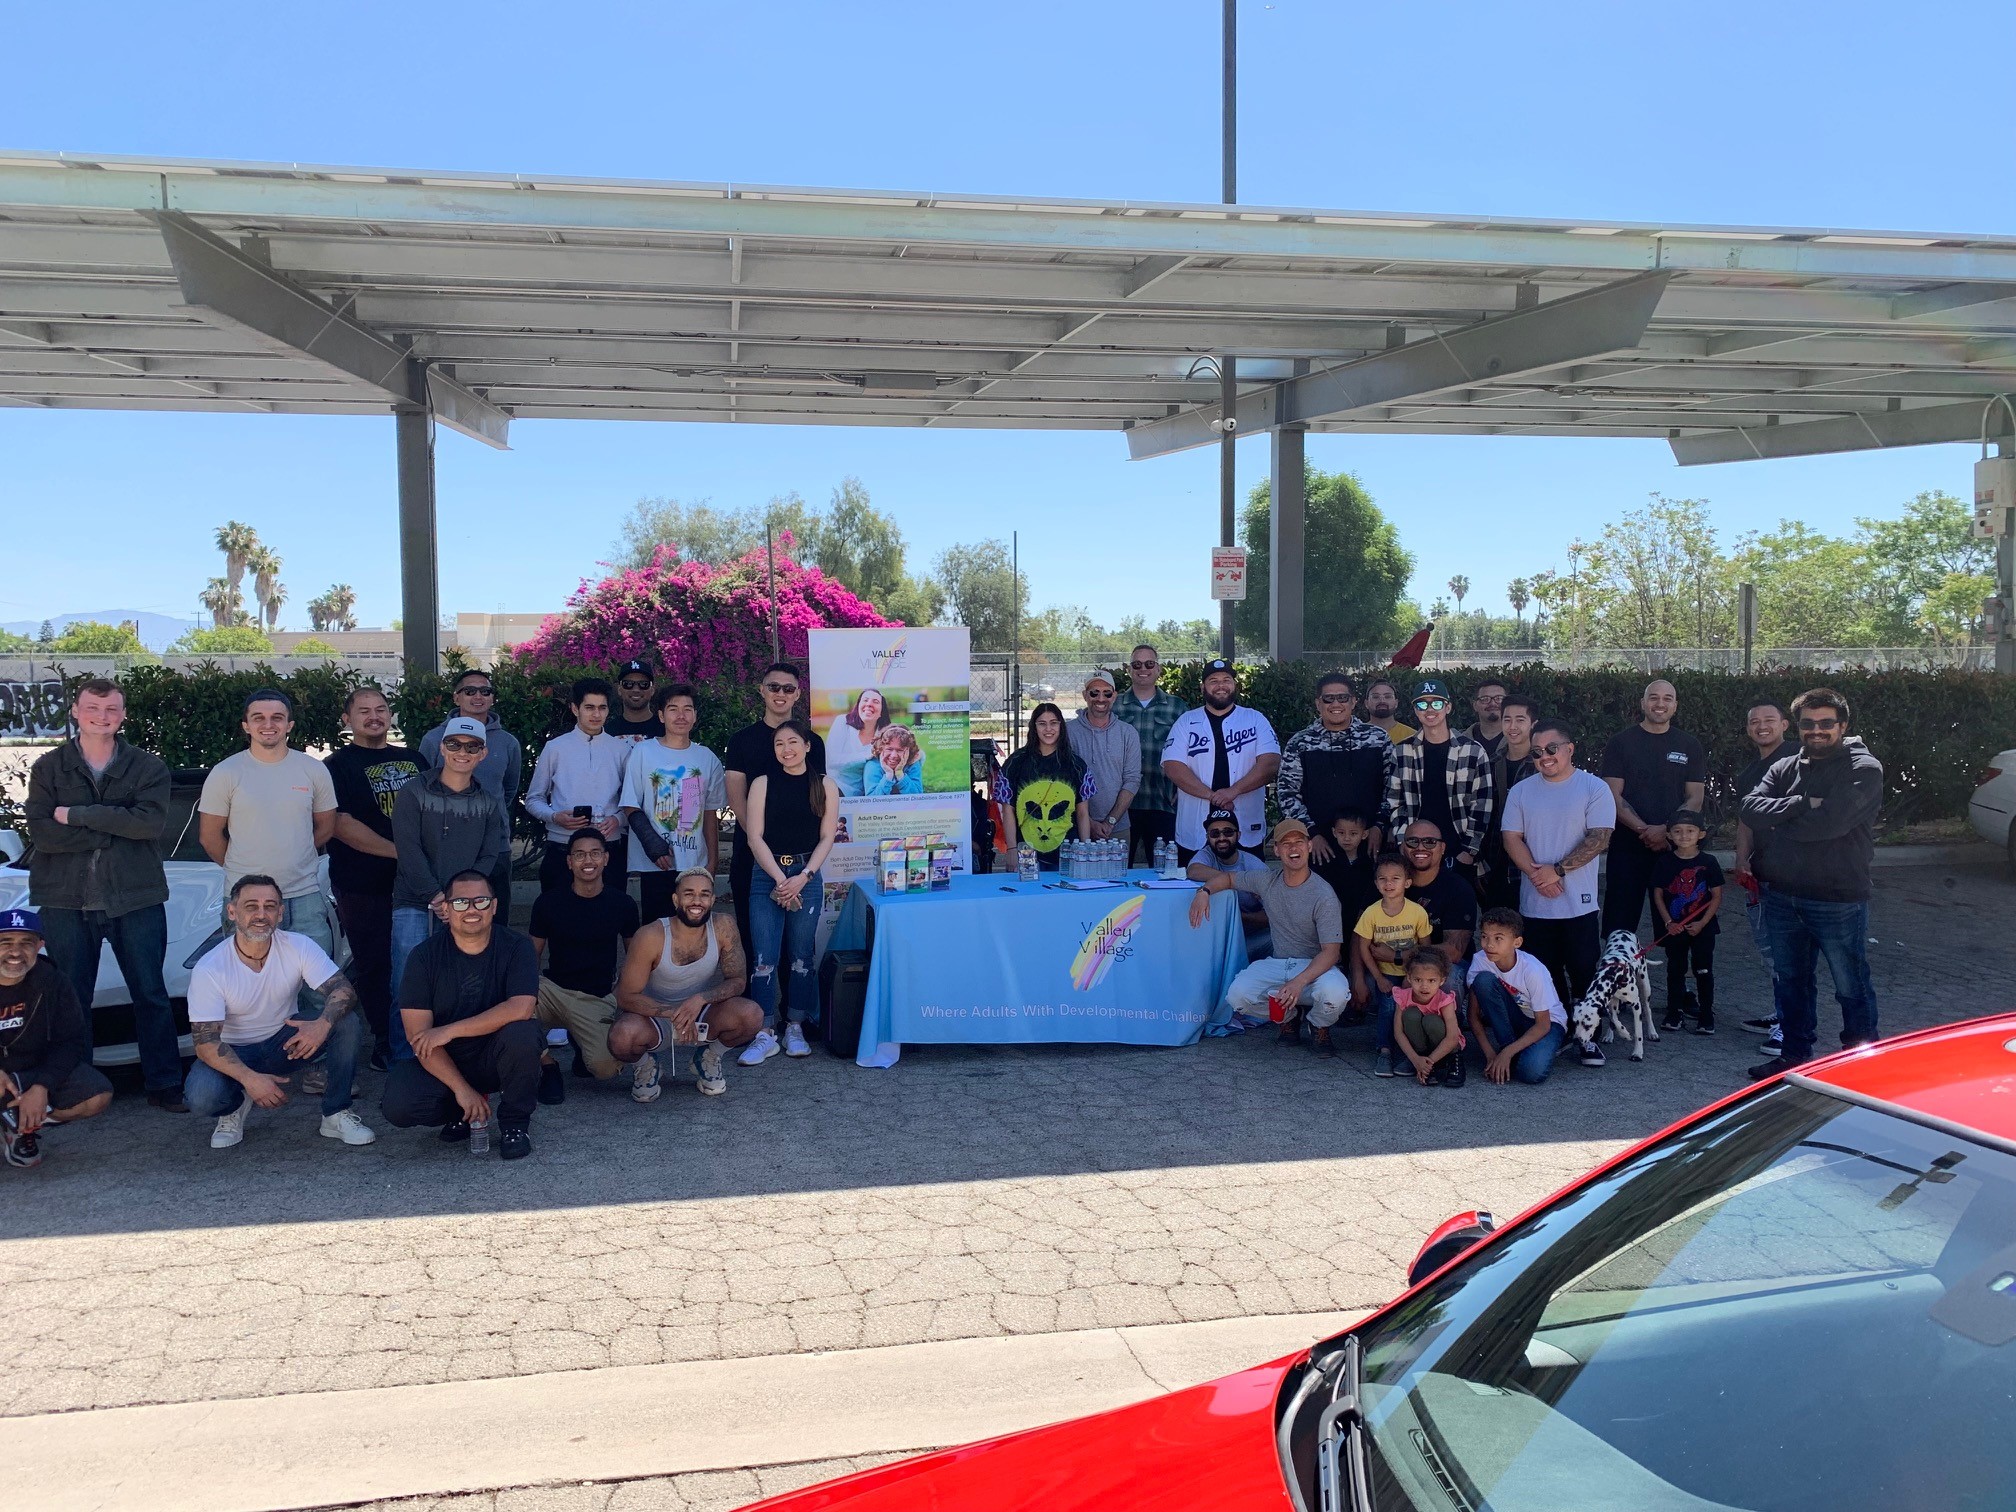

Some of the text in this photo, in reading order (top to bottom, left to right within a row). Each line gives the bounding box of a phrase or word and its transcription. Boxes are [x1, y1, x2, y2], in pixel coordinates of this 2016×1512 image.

[872, 650, 906, 658] VALLEY
[860, 658, 906, 669] VILLAGE
[924, 703, 938, 711] Our
[373, 781, 390, 793] GAS
[11, 912, 24, 926] LA
[1081, 918, 1132, 944] Valley
[1079, 937, 1134, 962] Village
[920, 1005, 967, 1018] Where
[971, 1005, 1018, 1018] Adults
[1022, 1004, 1055, 1017] With
[1059, 1003, 1159, 1020] Developmental
